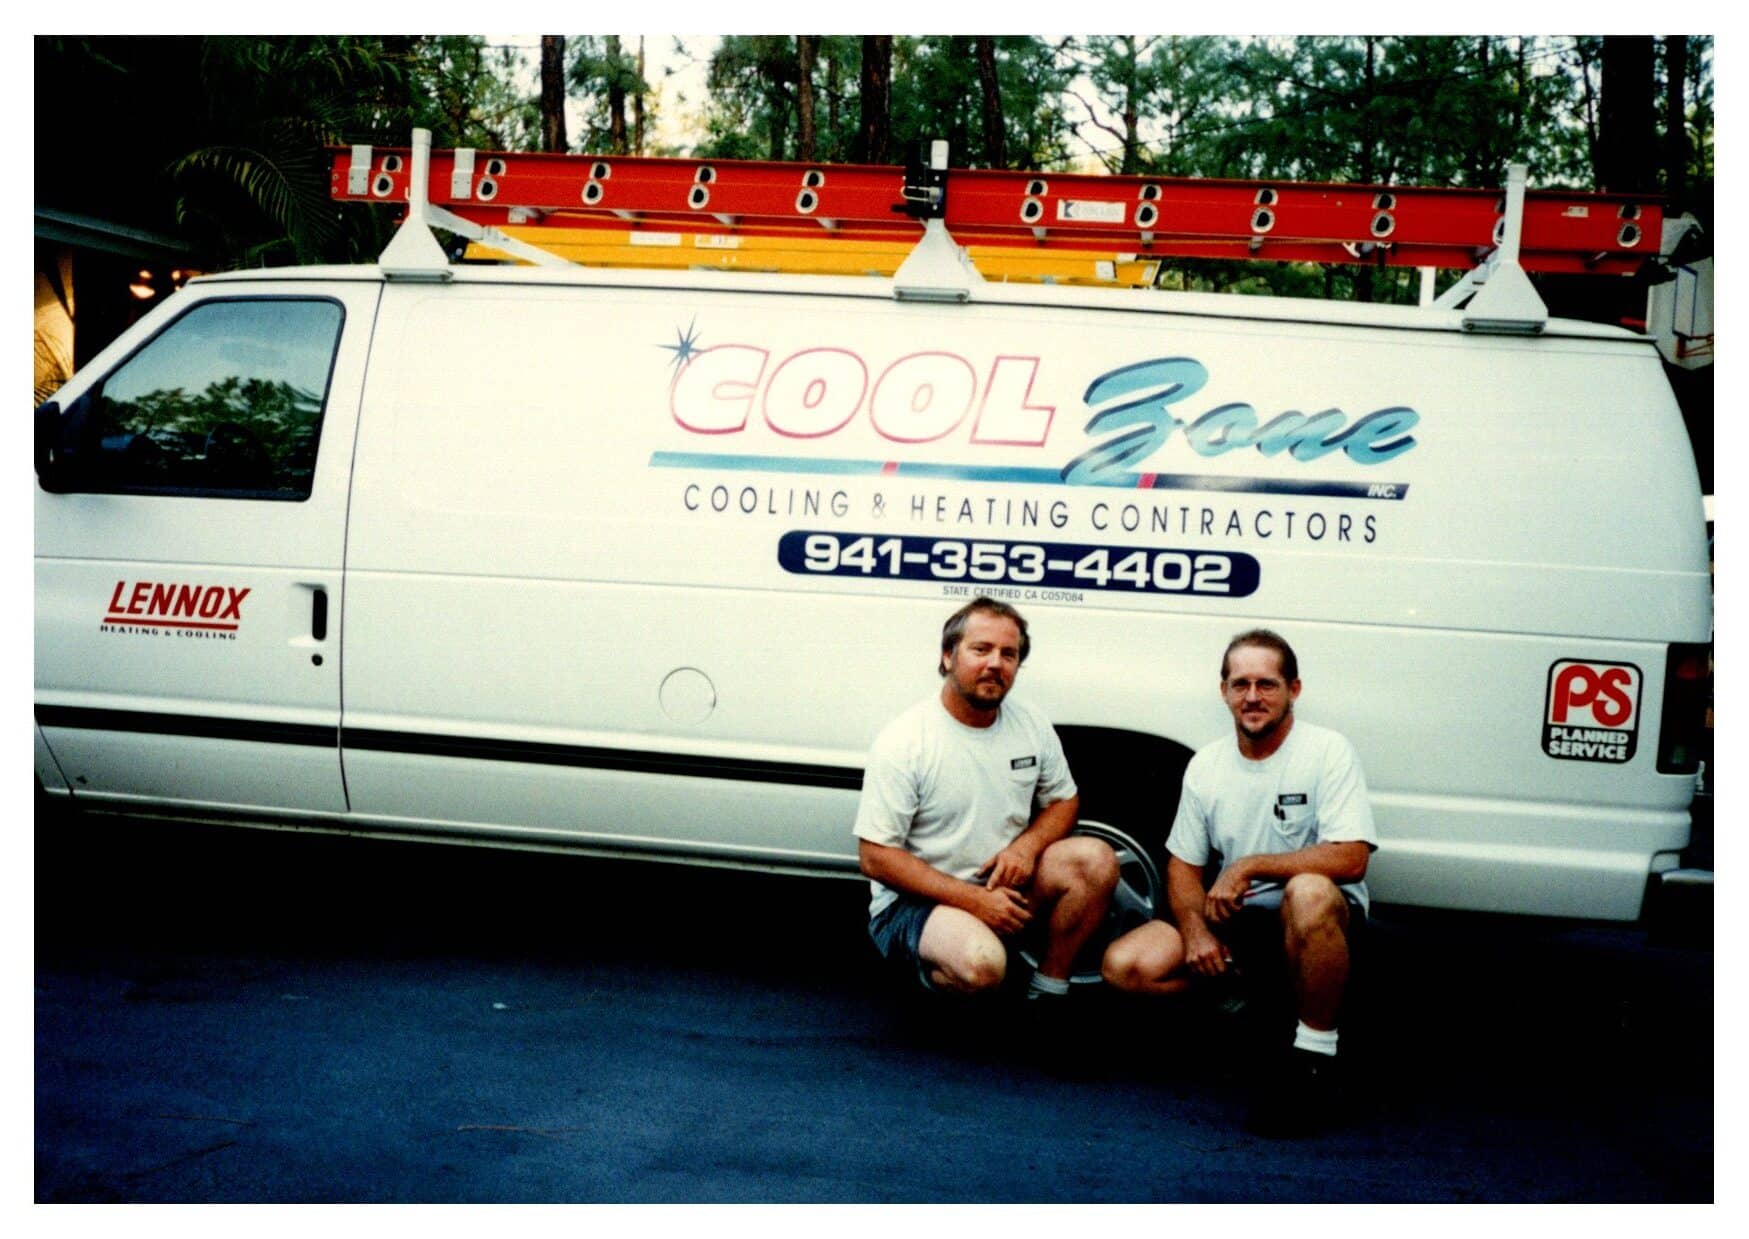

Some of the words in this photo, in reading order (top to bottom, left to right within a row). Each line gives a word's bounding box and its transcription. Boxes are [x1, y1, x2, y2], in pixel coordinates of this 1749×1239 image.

[668, 344, 1056, 448] COOL
[1060, 356, 1421, 484] Zone
[1367, 484, 1397, 498] INC.
[683, 484, 849, 517] COOLING
[871, 492, 887, 520] &
[911, 494, 1069, 528] HEATING
[1091, 502, 1377, 543] CONTRACTORS
[804, 535, 1231, 592] 941-353-4402
[108, 581, 252, 620] LENNOX
[943, 585, 969, 597] STATE
[973, 587, 1021, 600] CERTIFIED
[1024, 590, 1038, 600] CA
[100, 625, 158, 636] HEATING
[176, 629, 237, 640] COOLING
[1551, 664, 1632, 727] PS
[1549, 740, 1628, 760] SERVICE
[1550, 727, 1629, 745] PLANNED
